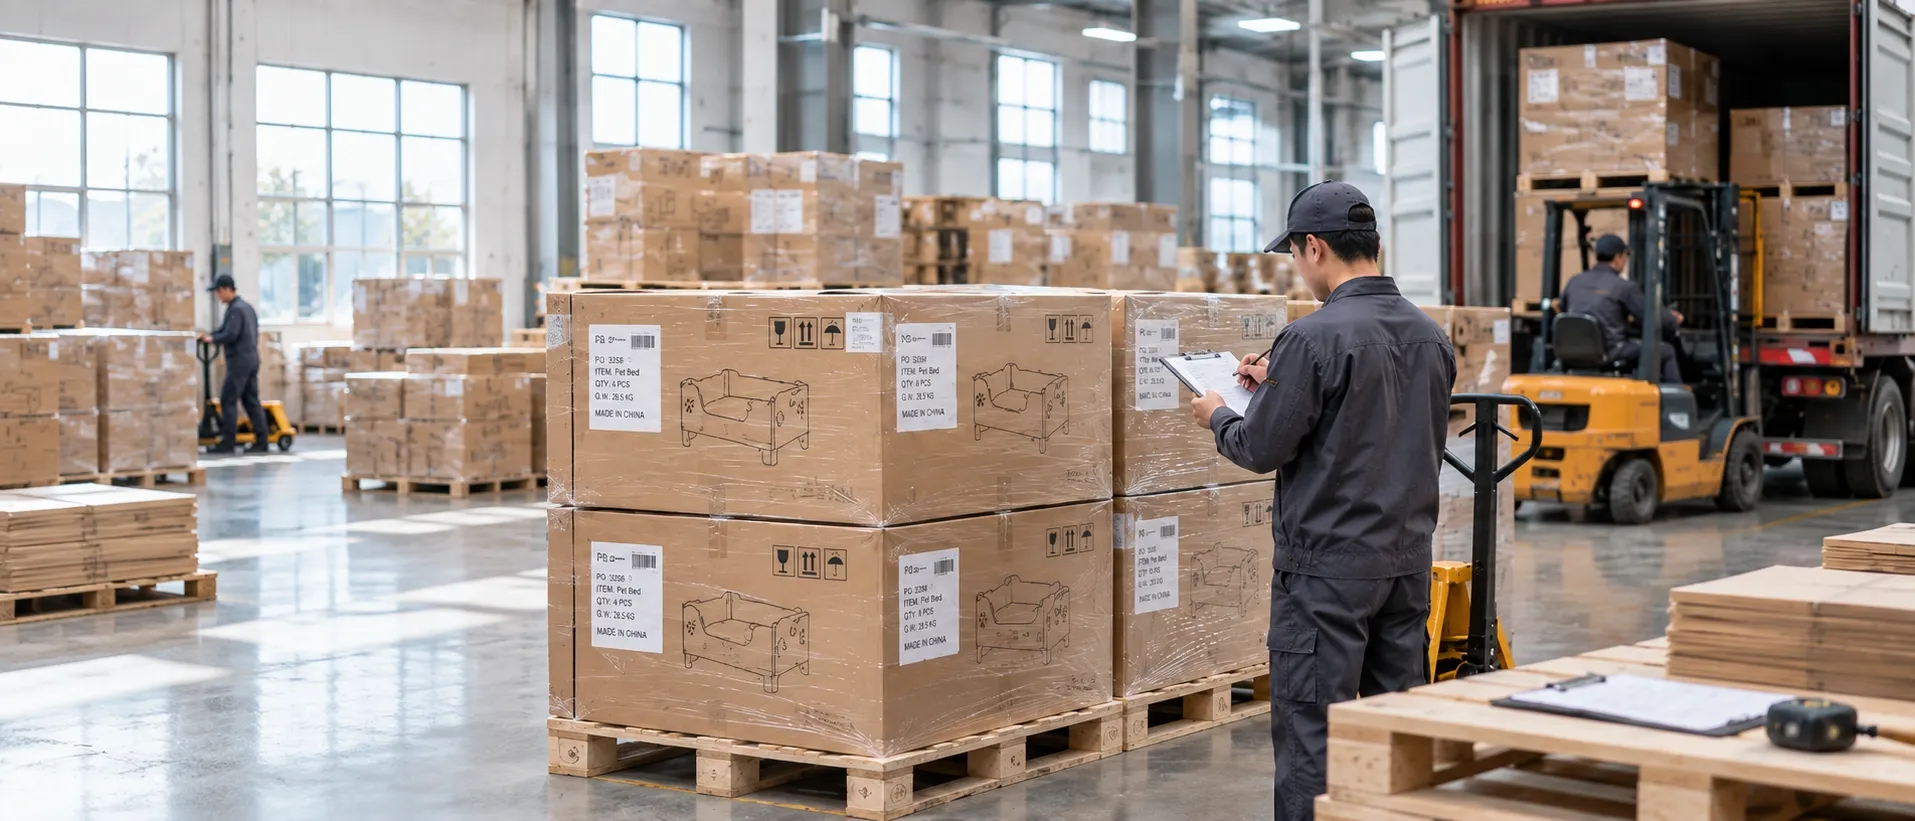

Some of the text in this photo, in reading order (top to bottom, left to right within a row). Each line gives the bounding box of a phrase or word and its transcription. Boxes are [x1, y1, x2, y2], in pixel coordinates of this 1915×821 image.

[615, 368, 625, 376] Pet
[627, 368, 640, 376] Bed
[617, 380, 631, 388] PCS
[920, 378, 931, 387] PCS
[594, 409, 645, 419] MADE IN CHINA
[919, 408, 925, 417] IN
[628, 587, 641, 596] Bed
[930, 592, 943, 603] Bed
[618, 598, 633, 607] PCS
[922, 606, 934, 616] PCS
[596, 626, 648, 639] MADE IN CHINA
[921, 638, 928, 648] IN
[928, 634, 947, 646] CHINA
